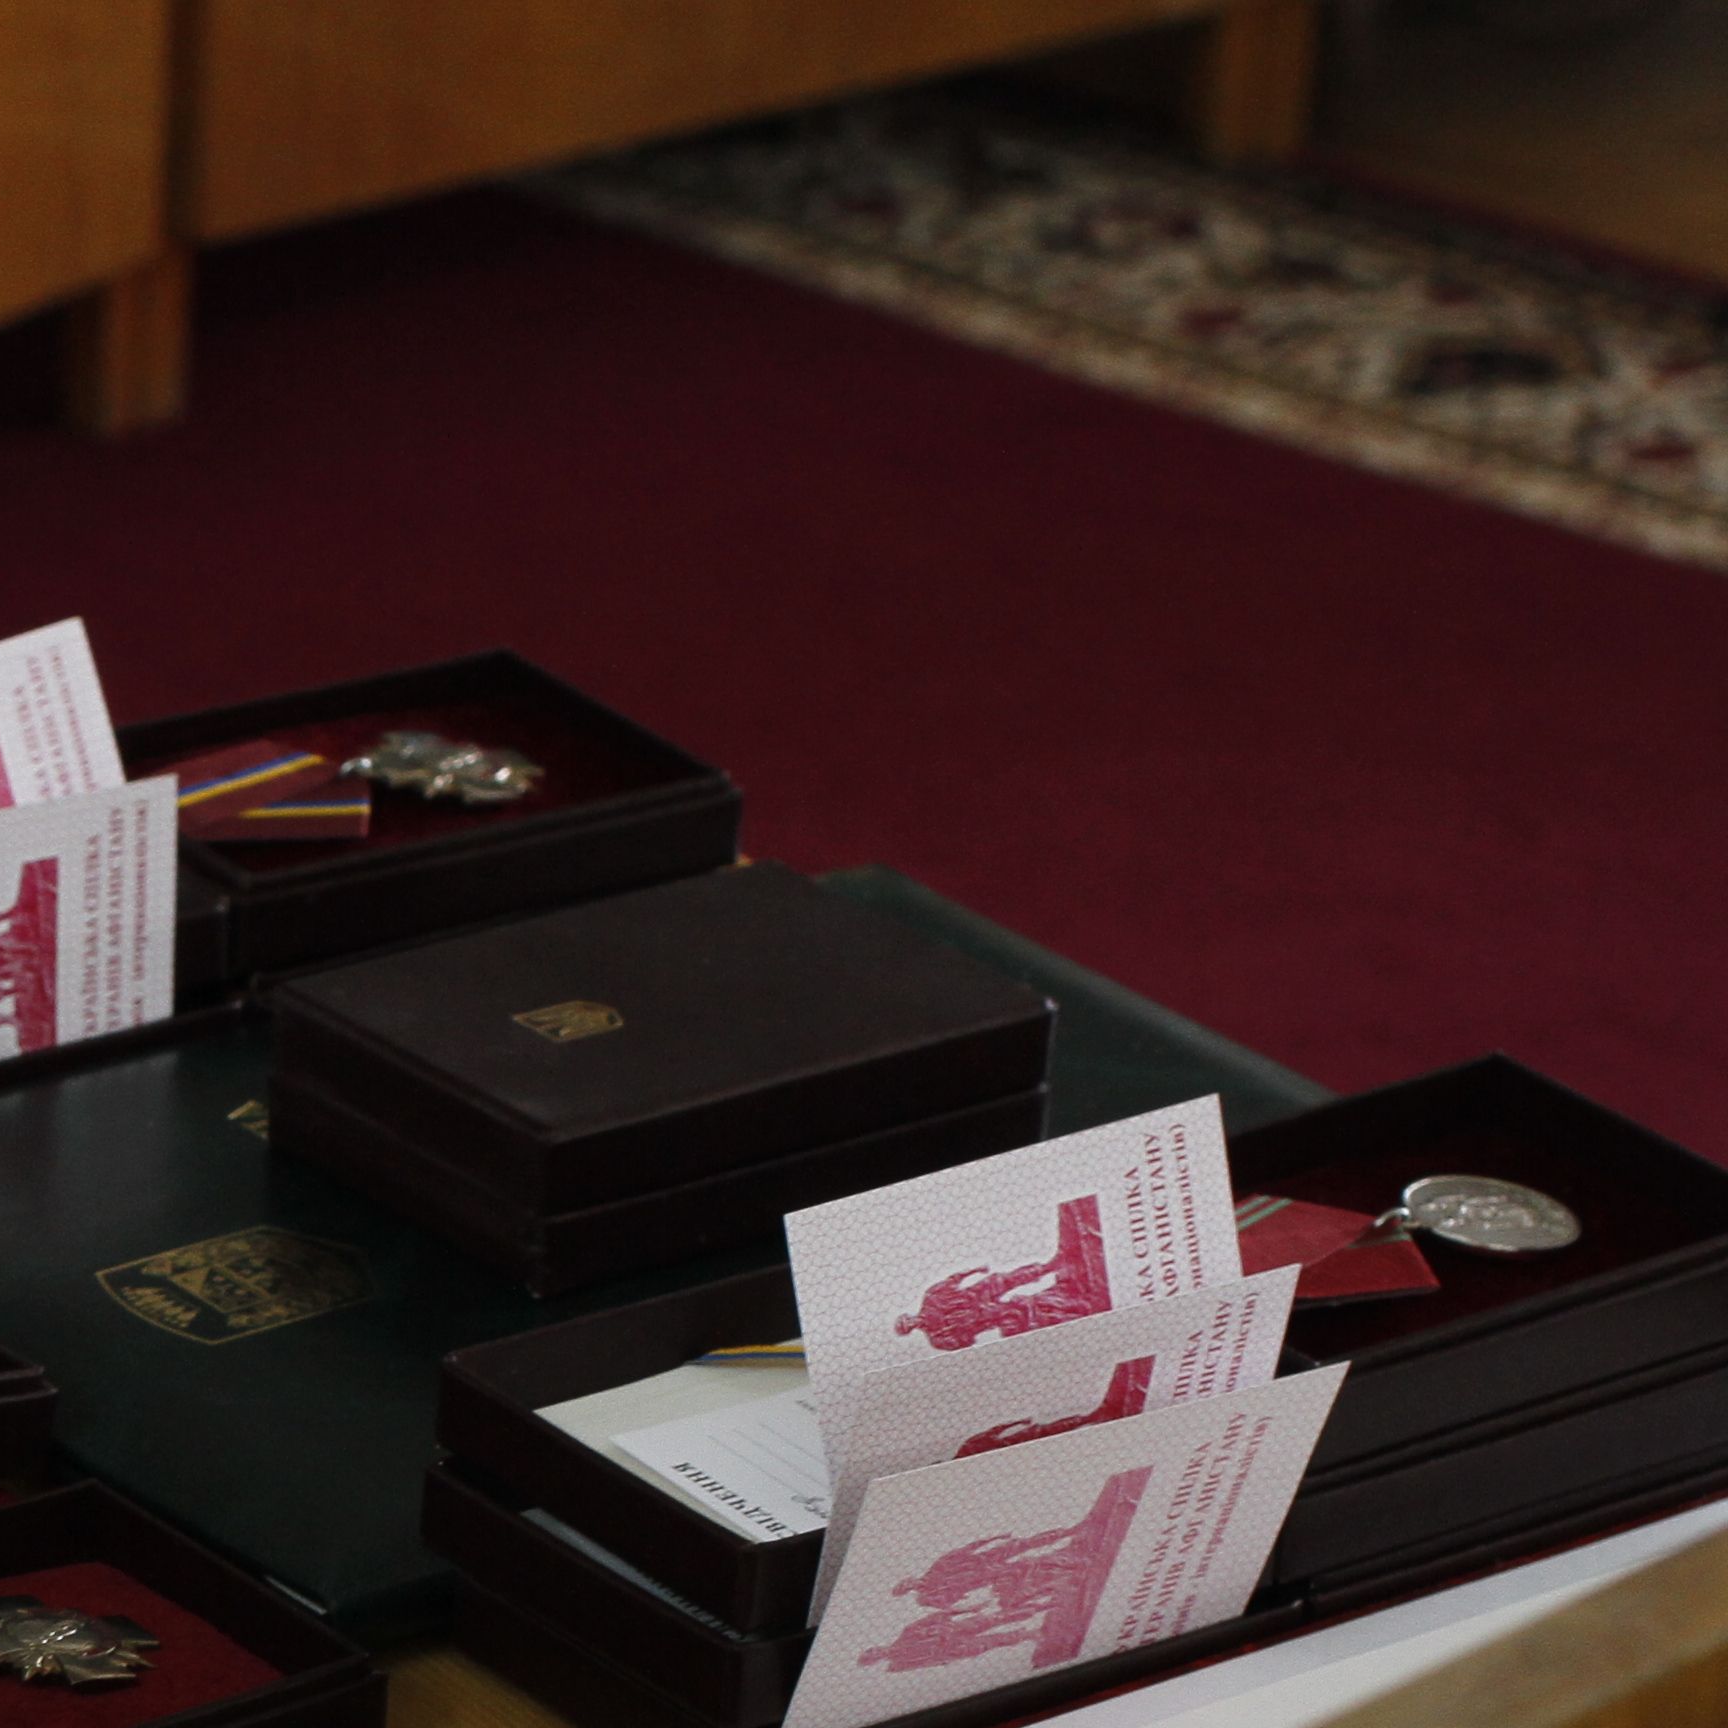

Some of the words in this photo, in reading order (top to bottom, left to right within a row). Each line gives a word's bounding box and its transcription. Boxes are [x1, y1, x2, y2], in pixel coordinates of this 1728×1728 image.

[1123, 1166, 1149, 1260] СПІЛКА
[1168, 1123, 1208, 1291] націоналістів)
[1171, 1329, 1204, 1401] ПІЛКА
[1196, 1300, 1233, 1395] НІСТАНУ
[1220, 1291, 1261, 1394] іоналістів)
[1166, 1441, 1212, 1521] СПІЛКА
[1139, 1562, 1185, 1647] ТЕРАНІВ
[1176, 1412, 1247, 1555] АФГАНІСТАНУ
